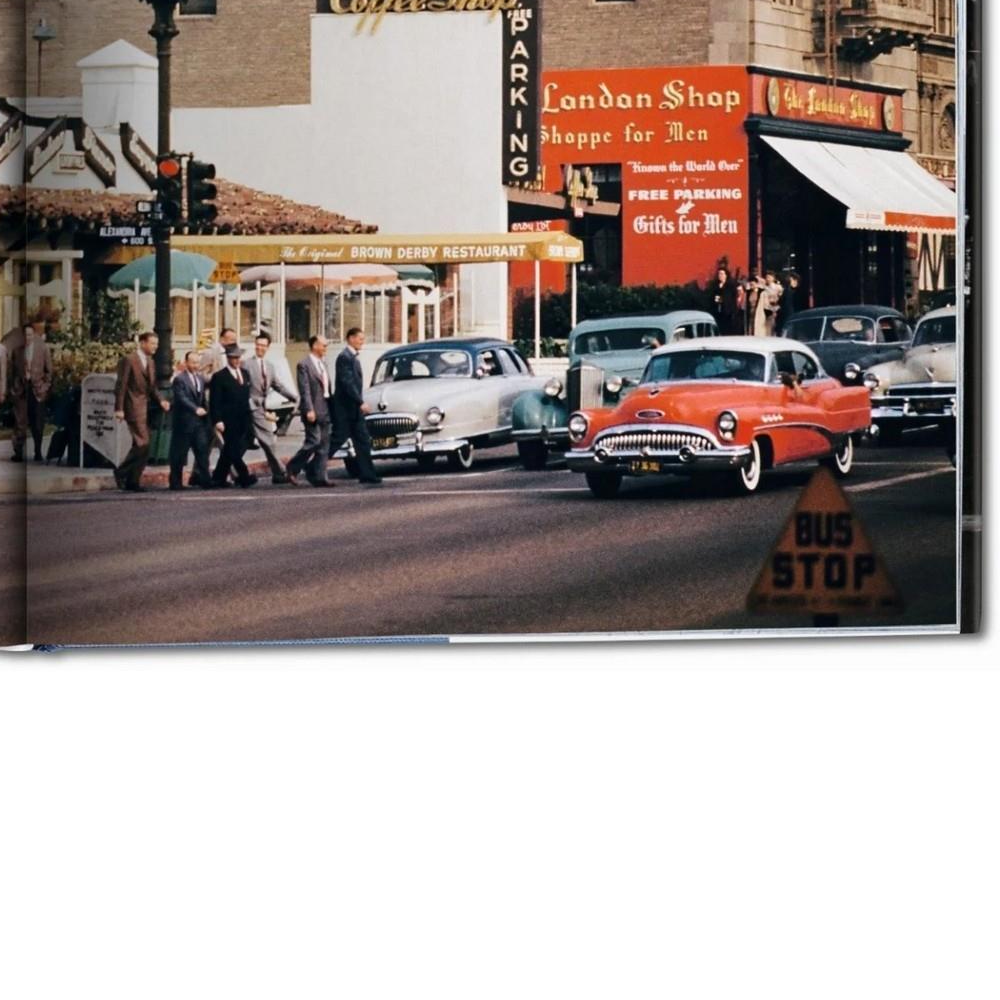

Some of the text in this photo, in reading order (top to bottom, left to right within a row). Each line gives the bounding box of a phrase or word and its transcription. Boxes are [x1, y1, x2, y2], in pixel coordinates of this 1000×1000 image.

[510, 18, 530, 177] PARKING
[541, 80, 741, 113] London Shop
[623, 122, 655, 143] for
[664, 121, 709, 143] Men
[628, 188, 742, 201] FREE PARKING
[633, 213, 738, 237] Gifts for Men
[351, 246, 392, 259] BROWN
[397, 246, 437, 259] DERBY
[443, 245, 526, 259] RESTAURANT
[795, 511, 853, 547] BUS
[773, 552, 876, 590] STOP
